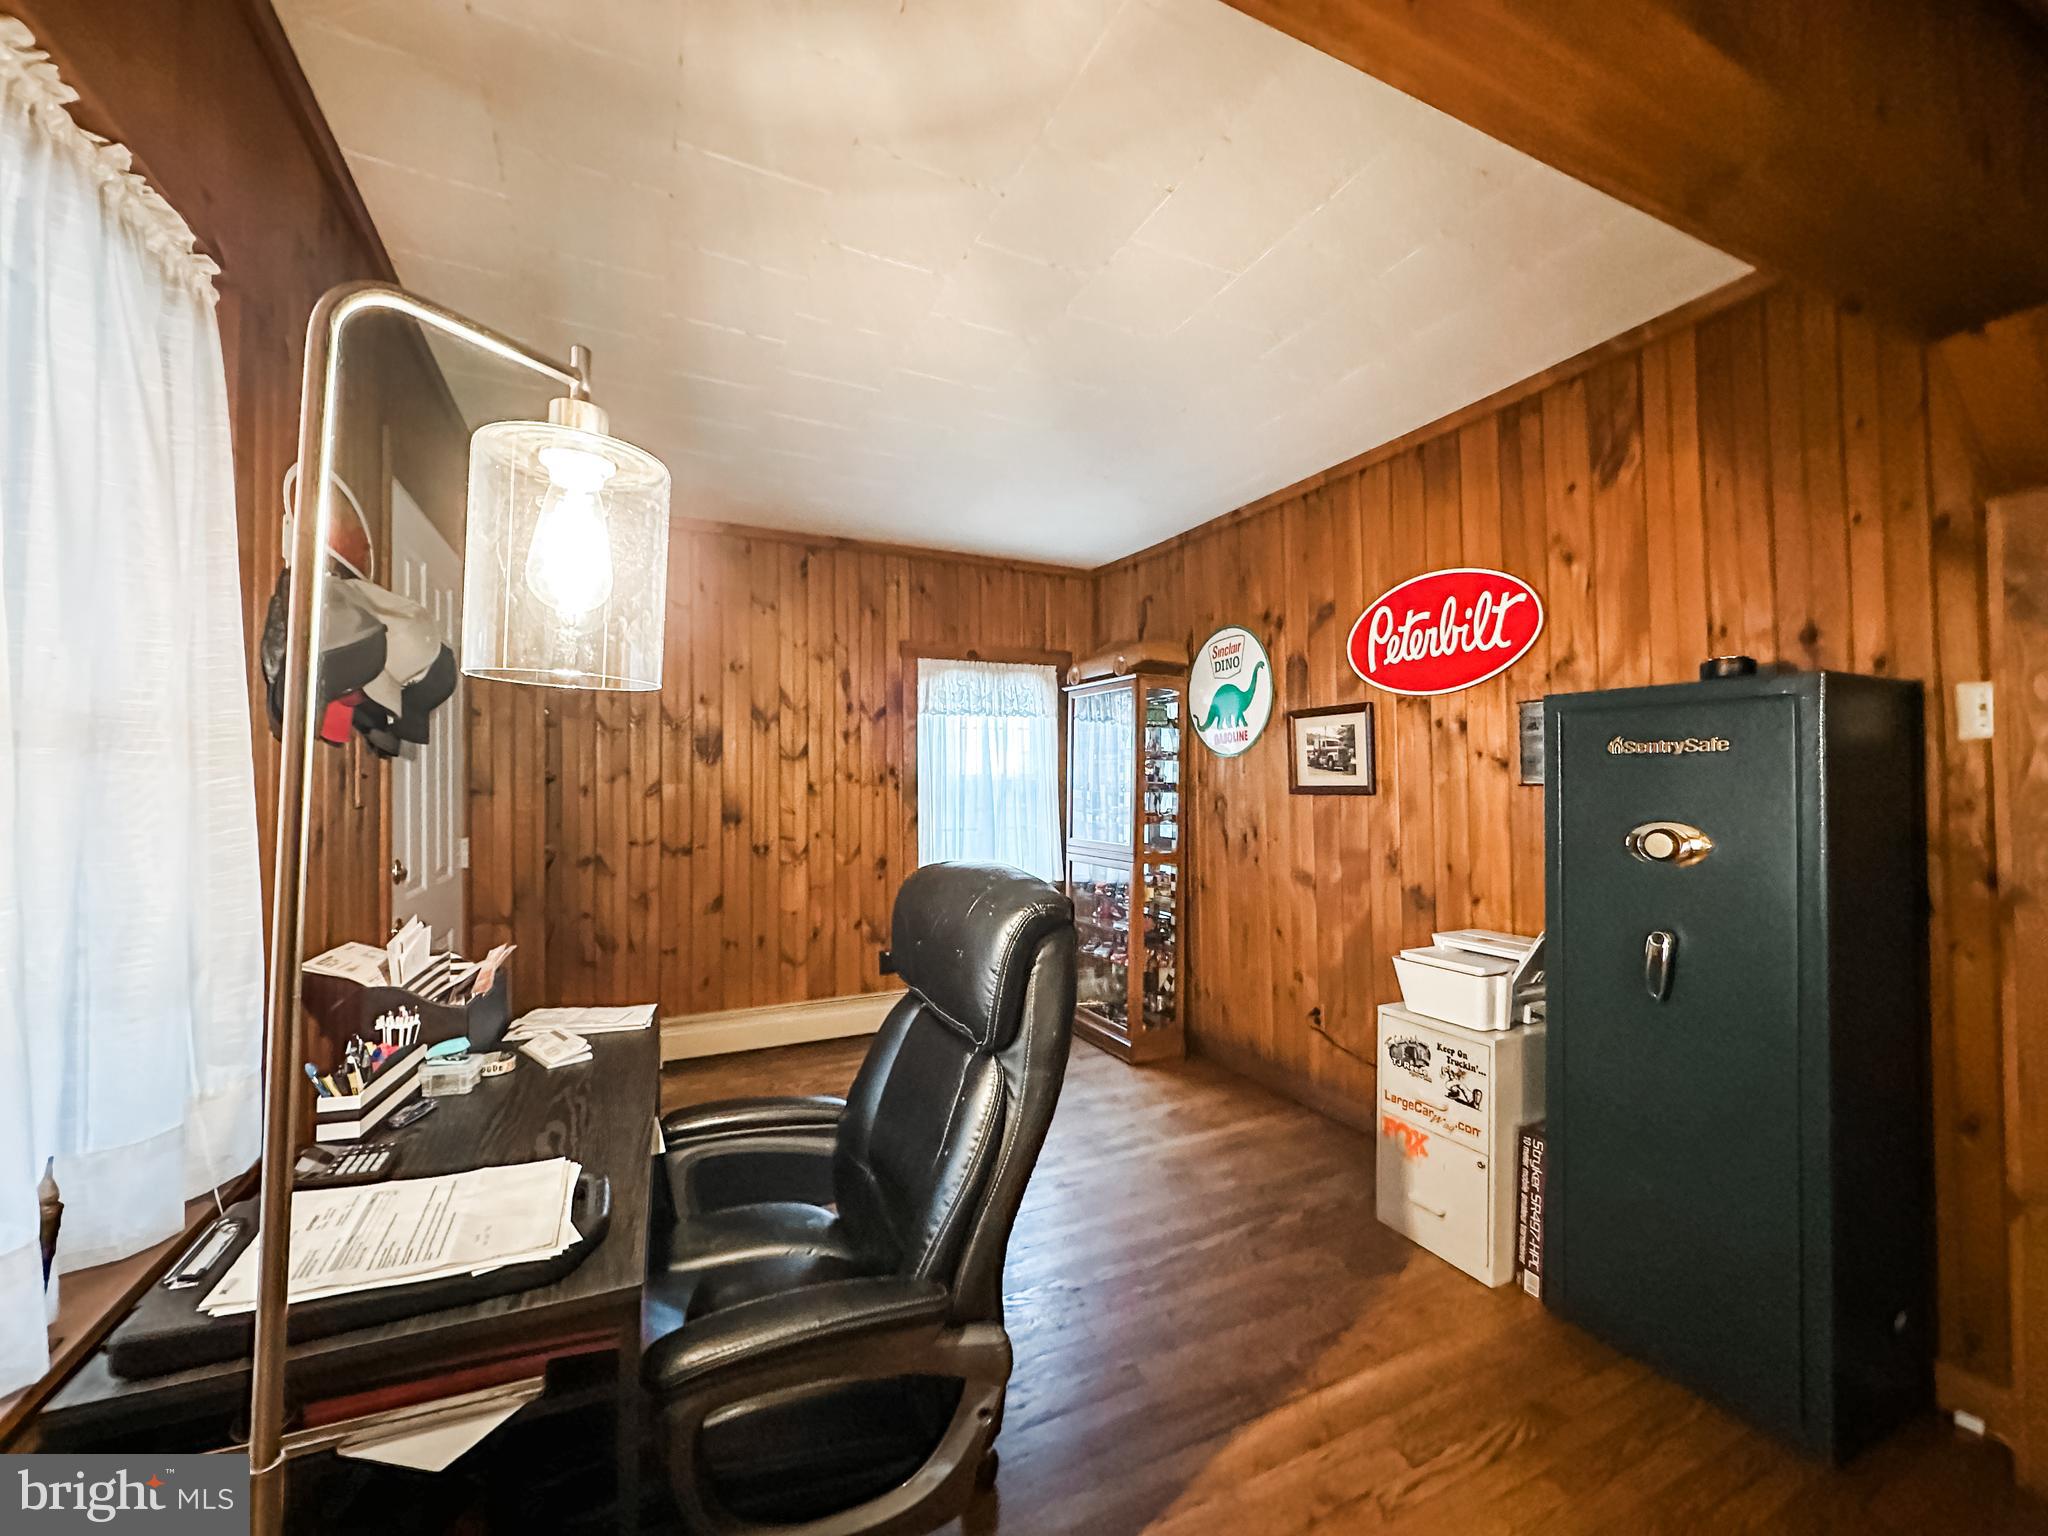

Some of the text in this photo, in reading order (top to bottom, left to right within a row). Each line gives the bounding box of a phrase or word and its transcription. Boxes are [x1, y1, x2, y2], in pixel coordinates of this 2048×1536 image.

[1367, 590, 1528, 674] Peterbilt
[1212, 642, 1242, 660] Sinclair
[1214, 656, 1240, 673] DINO
[1622, 736, 1730, 755] SentrySafe
[1436, 1042, 1468, 1060] Keep On
[1529, 1138, 1544, 1193] Stryker
